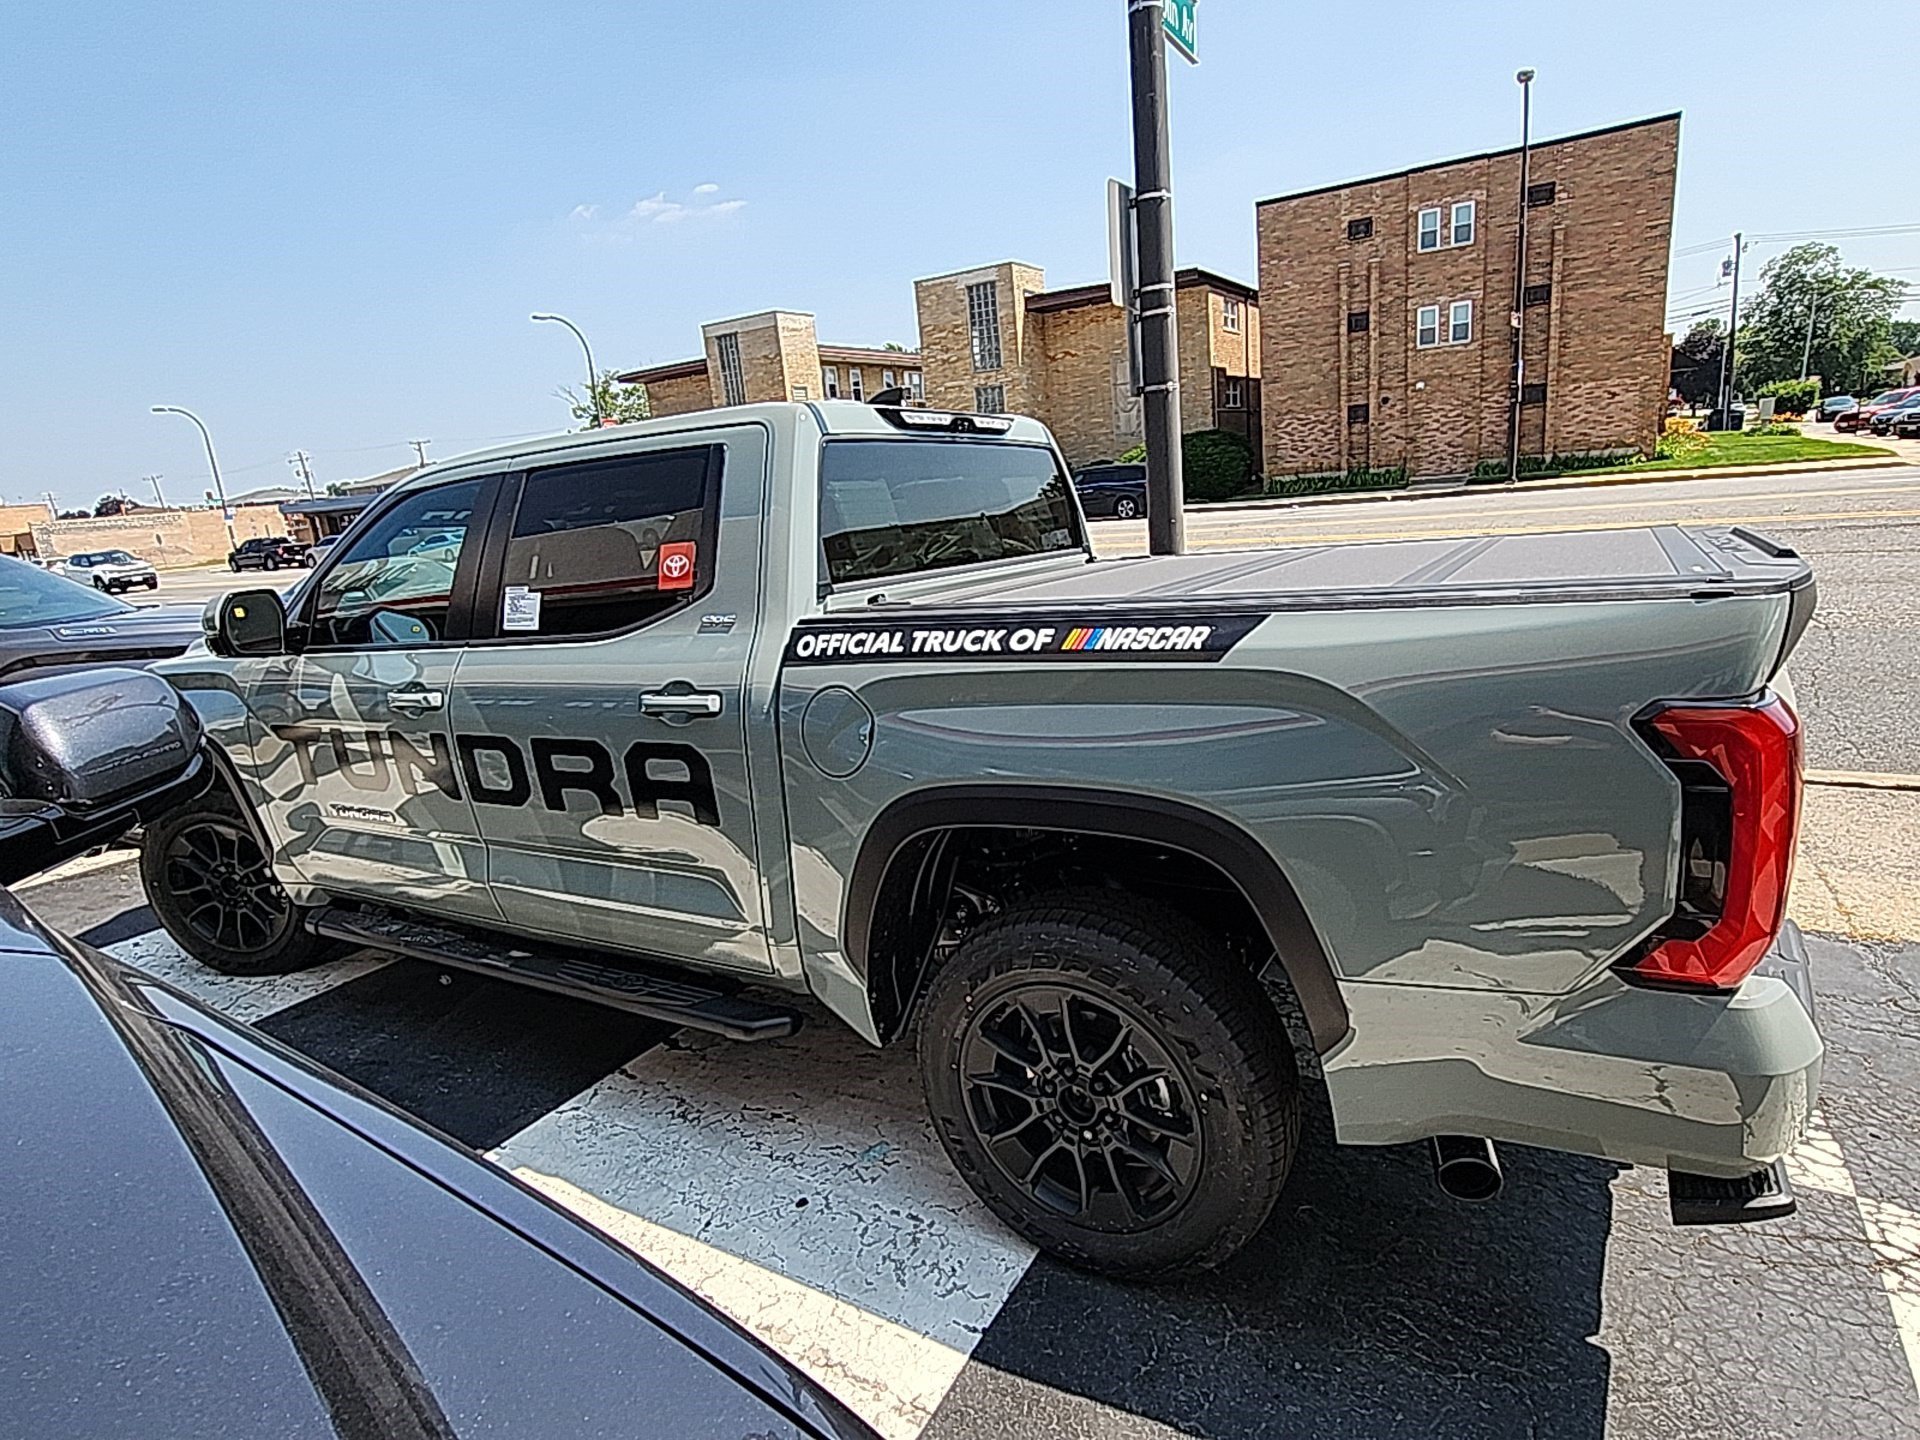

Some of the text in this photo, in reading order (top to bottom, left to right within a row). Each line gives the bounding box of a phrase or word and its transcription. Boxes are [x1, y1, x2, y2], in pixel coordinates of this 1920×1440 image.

[797, 626, 1213, 657] OFFICIAL TRUCK OF NASCAR
[270, 724, 722, 826] TUNDRA
[329, 803, 396, 823] TUNDRA
